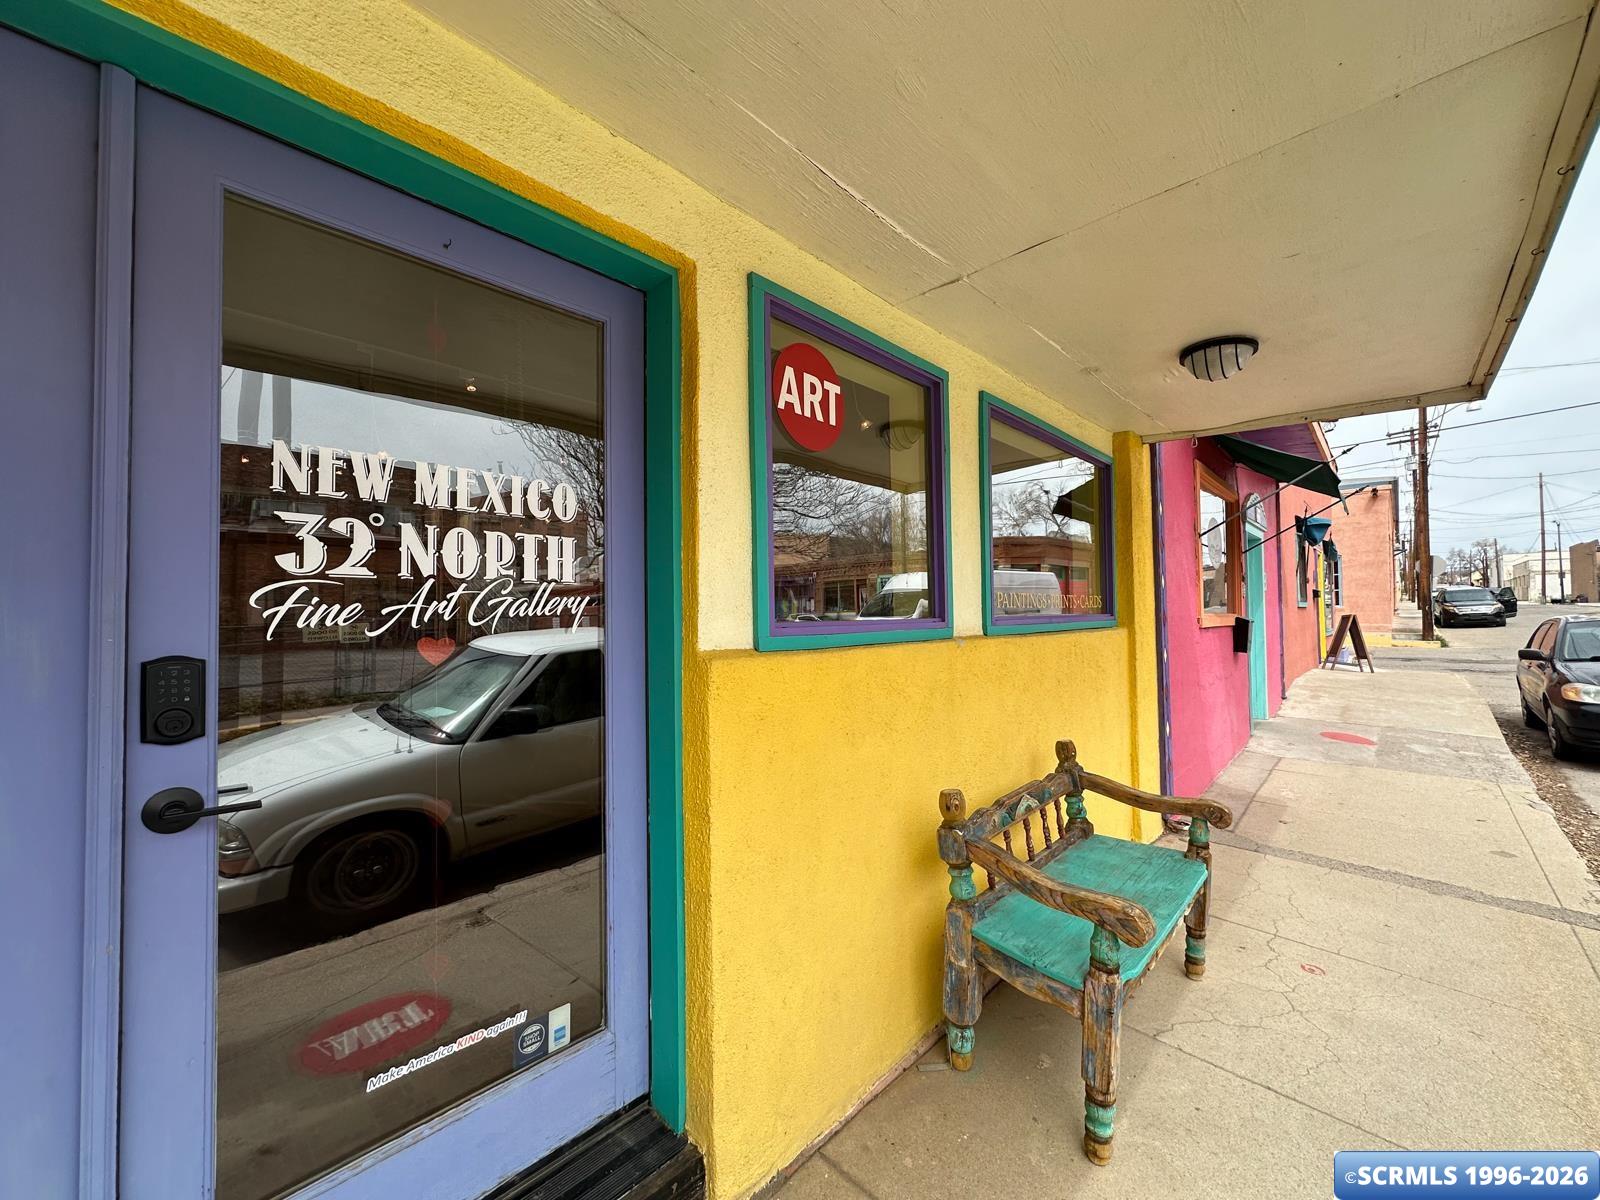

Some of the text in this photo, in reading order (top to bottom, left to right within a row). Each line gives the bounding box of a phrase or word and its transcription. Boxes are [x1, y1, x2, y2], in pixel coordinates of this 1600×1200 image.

[777, 365, 841, 427] ART
[269, 438, 580, 523] NEW MEXICO
[397, 522, 578, 585] NORTH
[249, 577, 592, 641] Fine Art Gallery
[367, 1010, 528, 1091] Make America KIND again!!!
[523, 1036, 541, 1047] SMALL
[524, 1031, 540, 1041] SHOP
